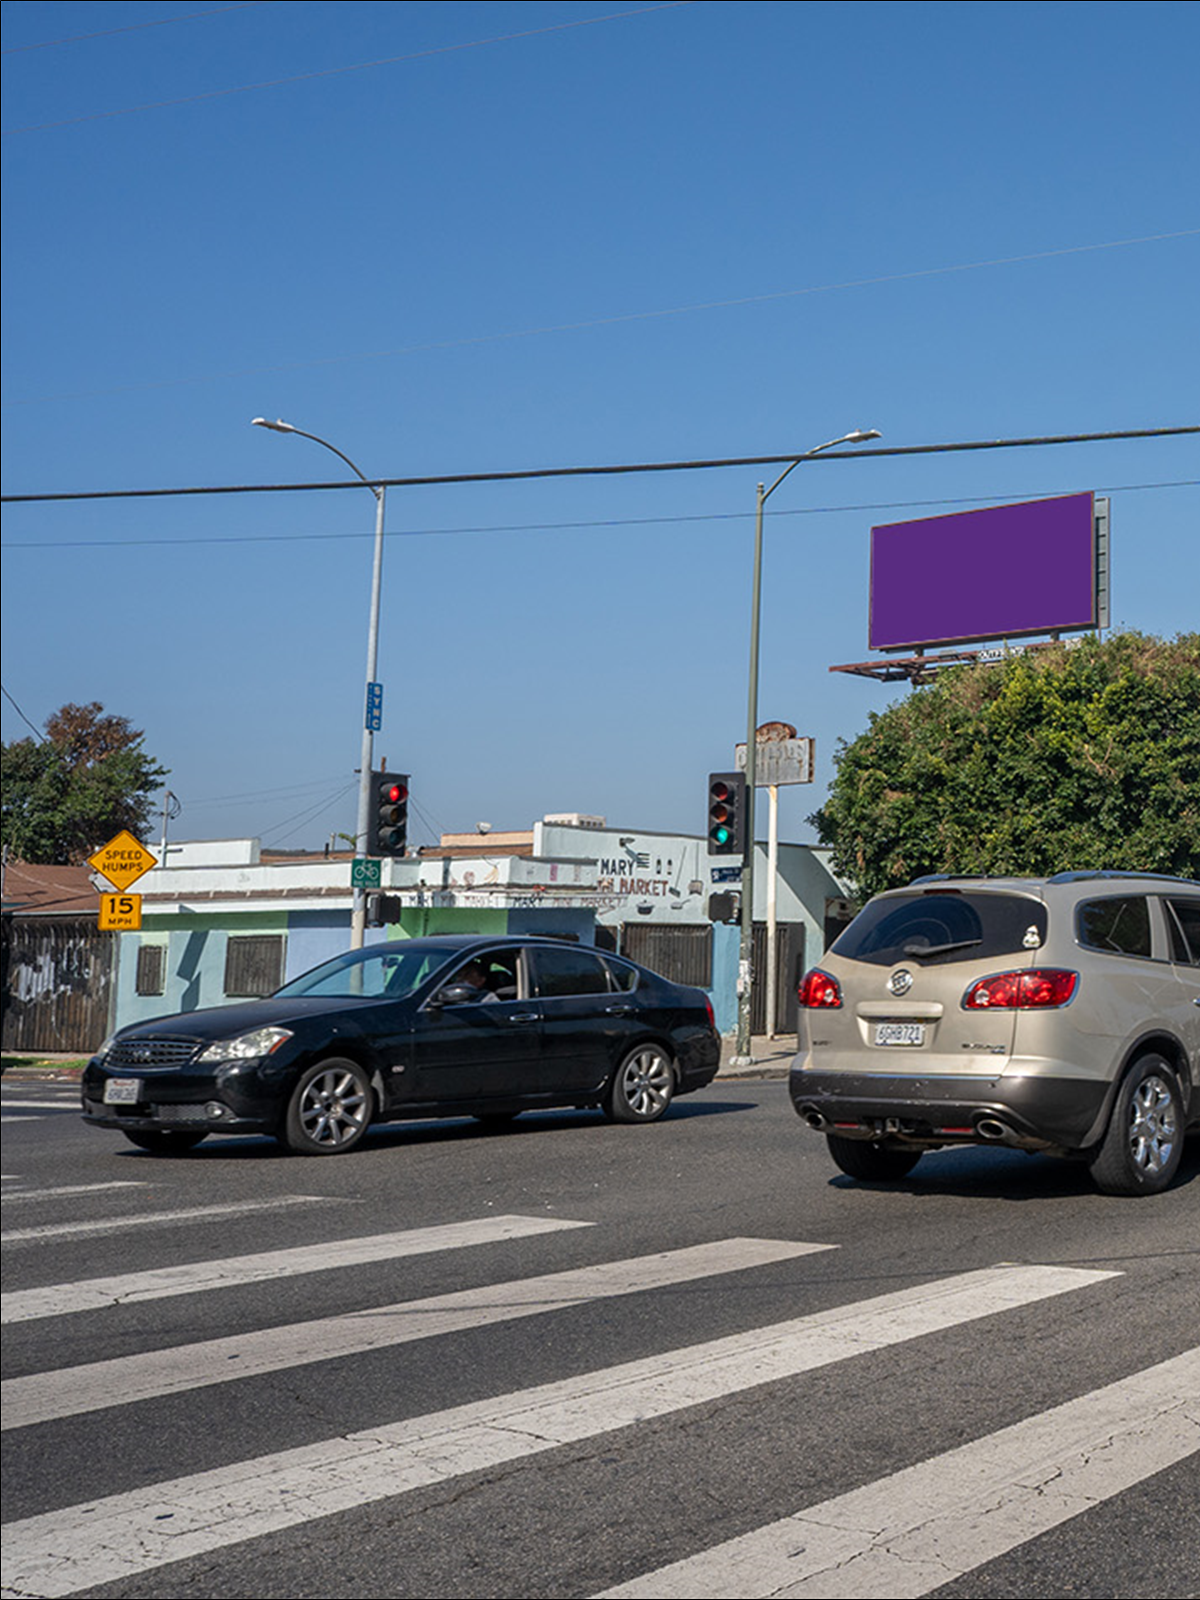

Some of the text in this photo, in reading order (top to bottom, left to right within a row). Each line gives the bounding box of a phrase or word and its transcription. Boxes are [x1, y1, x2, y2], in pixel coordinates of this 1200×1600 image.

[372, 686, 381, 728] SYNC
[105, 850, 142, 860] SPEED
[102, 862, 143, 872] HUMPS
[601, 859, 635, 875] MARY
[620, 878, 668, 897] MARKET
[109, 898, 133, 914] 15
